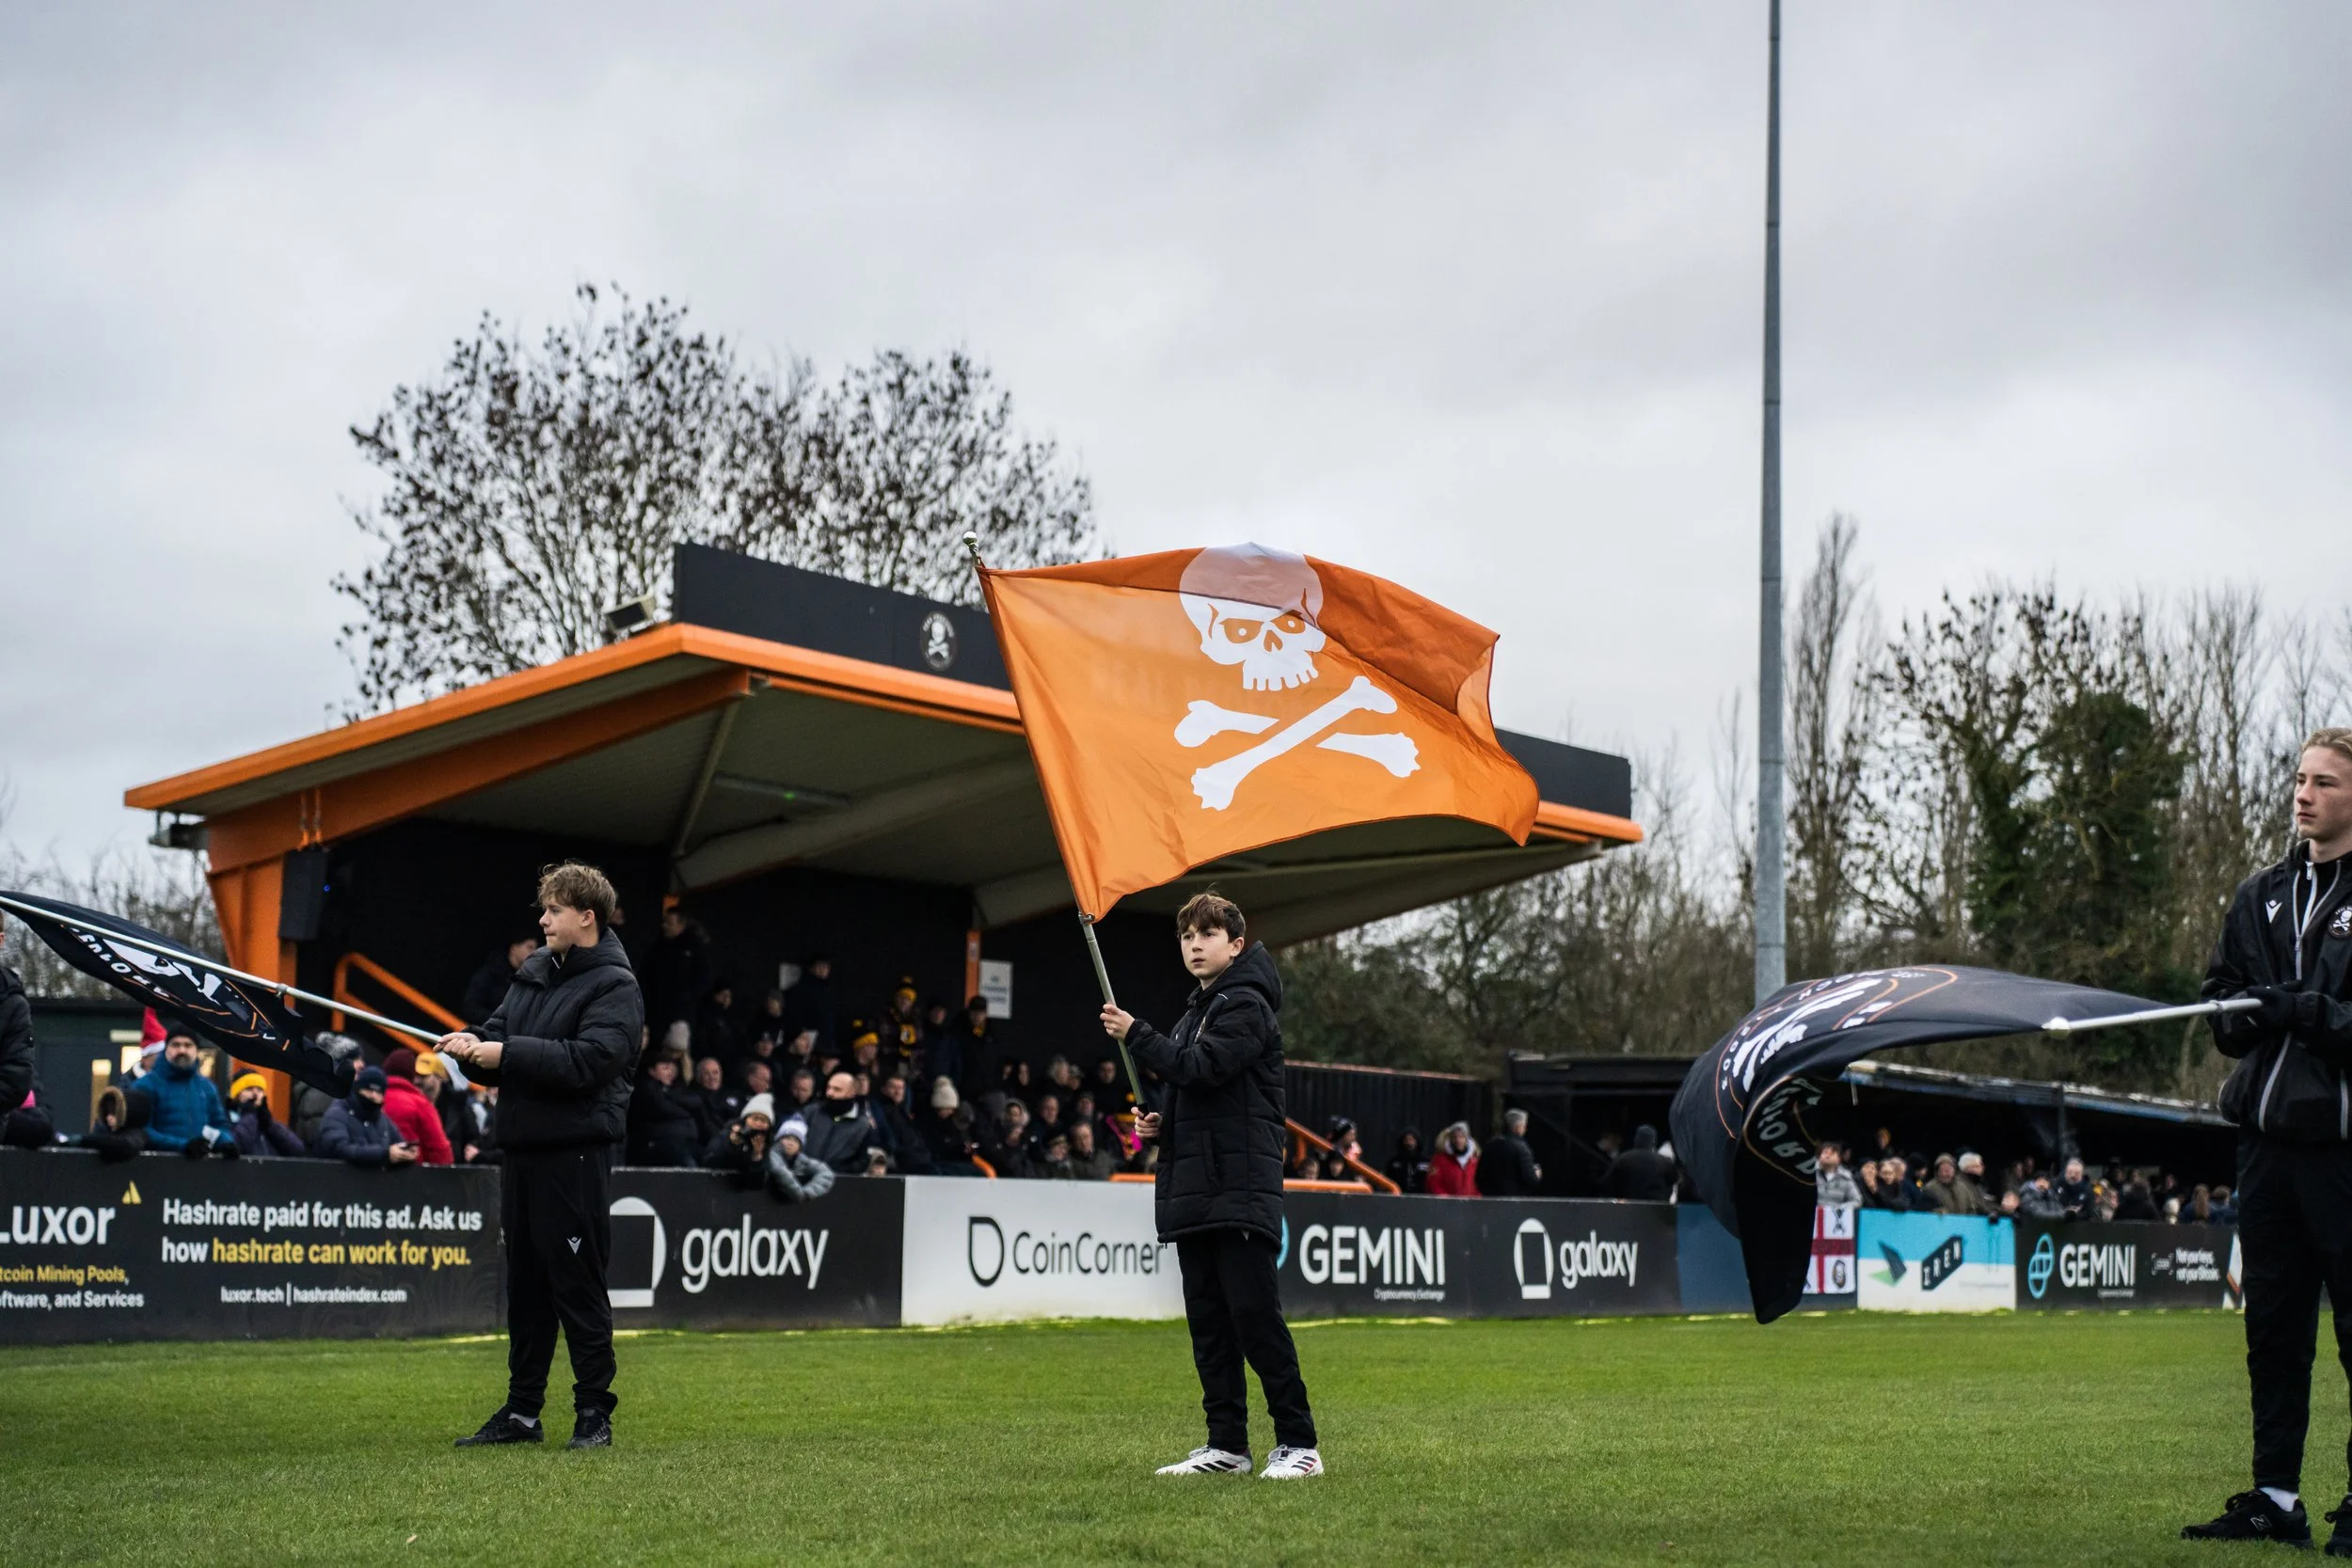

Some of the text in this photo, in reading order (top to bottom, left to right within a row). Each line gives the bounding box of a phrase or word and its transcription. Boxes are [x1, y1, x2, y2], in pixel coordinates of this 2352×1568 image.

[163, 1198, 483, 1233] Hashrate paid for this ad. Ask us
[162, 1236, 471, 1271] how hashrate can work for you.
[681, 1212, 829, 1293] galaxy
[1013, 1231, 1164, 1275] CoinCorner
[1299, 1224, 1446, 1285] GEMINI
[1560, 1229, 1638, 1290] galaxy
[2059, 1243, 2137, 1288] GEMINI
[37, 1264, 85, 1286] Mining
[87, 1264, 130, 1286] Pools,
[220, 1286, 284, 1303] luxor.tech
[294, 1286, 407, 1303] hashrateindex.com
[0, 1290, 145, 1311] ftware, and Services
